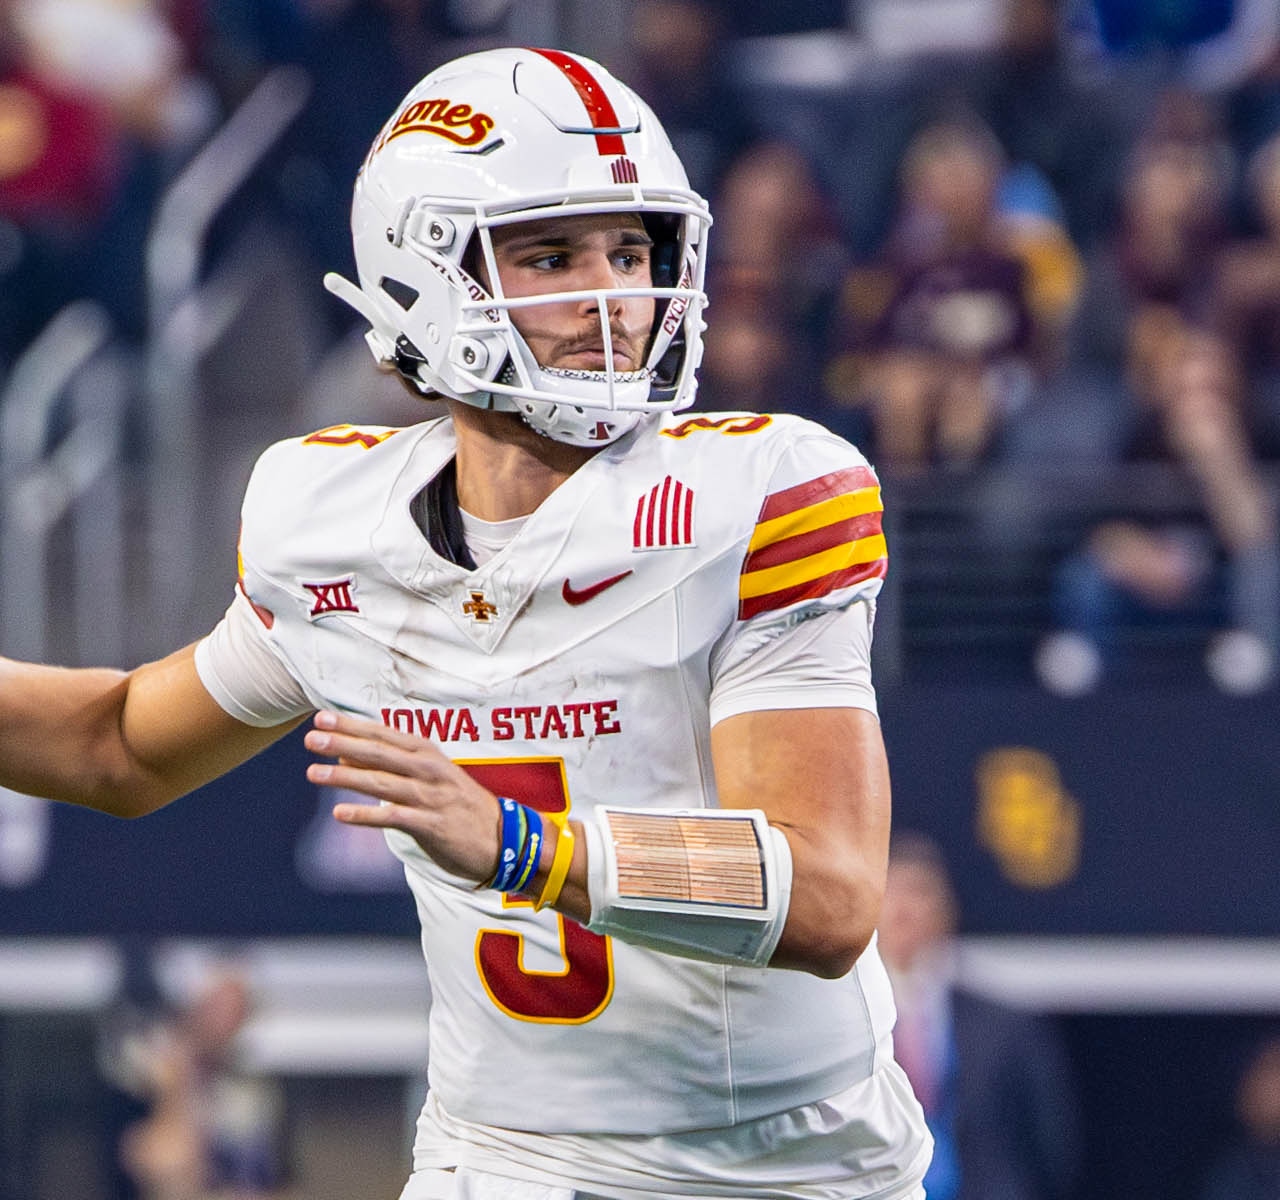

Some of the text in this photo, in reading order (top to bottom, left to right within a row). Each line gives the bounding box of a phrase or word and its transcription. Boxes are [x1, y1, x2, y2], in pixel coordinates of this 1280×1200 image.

[302, 579, 360, 617] XII
[381, 700, 622, 742] IOWA STATE
